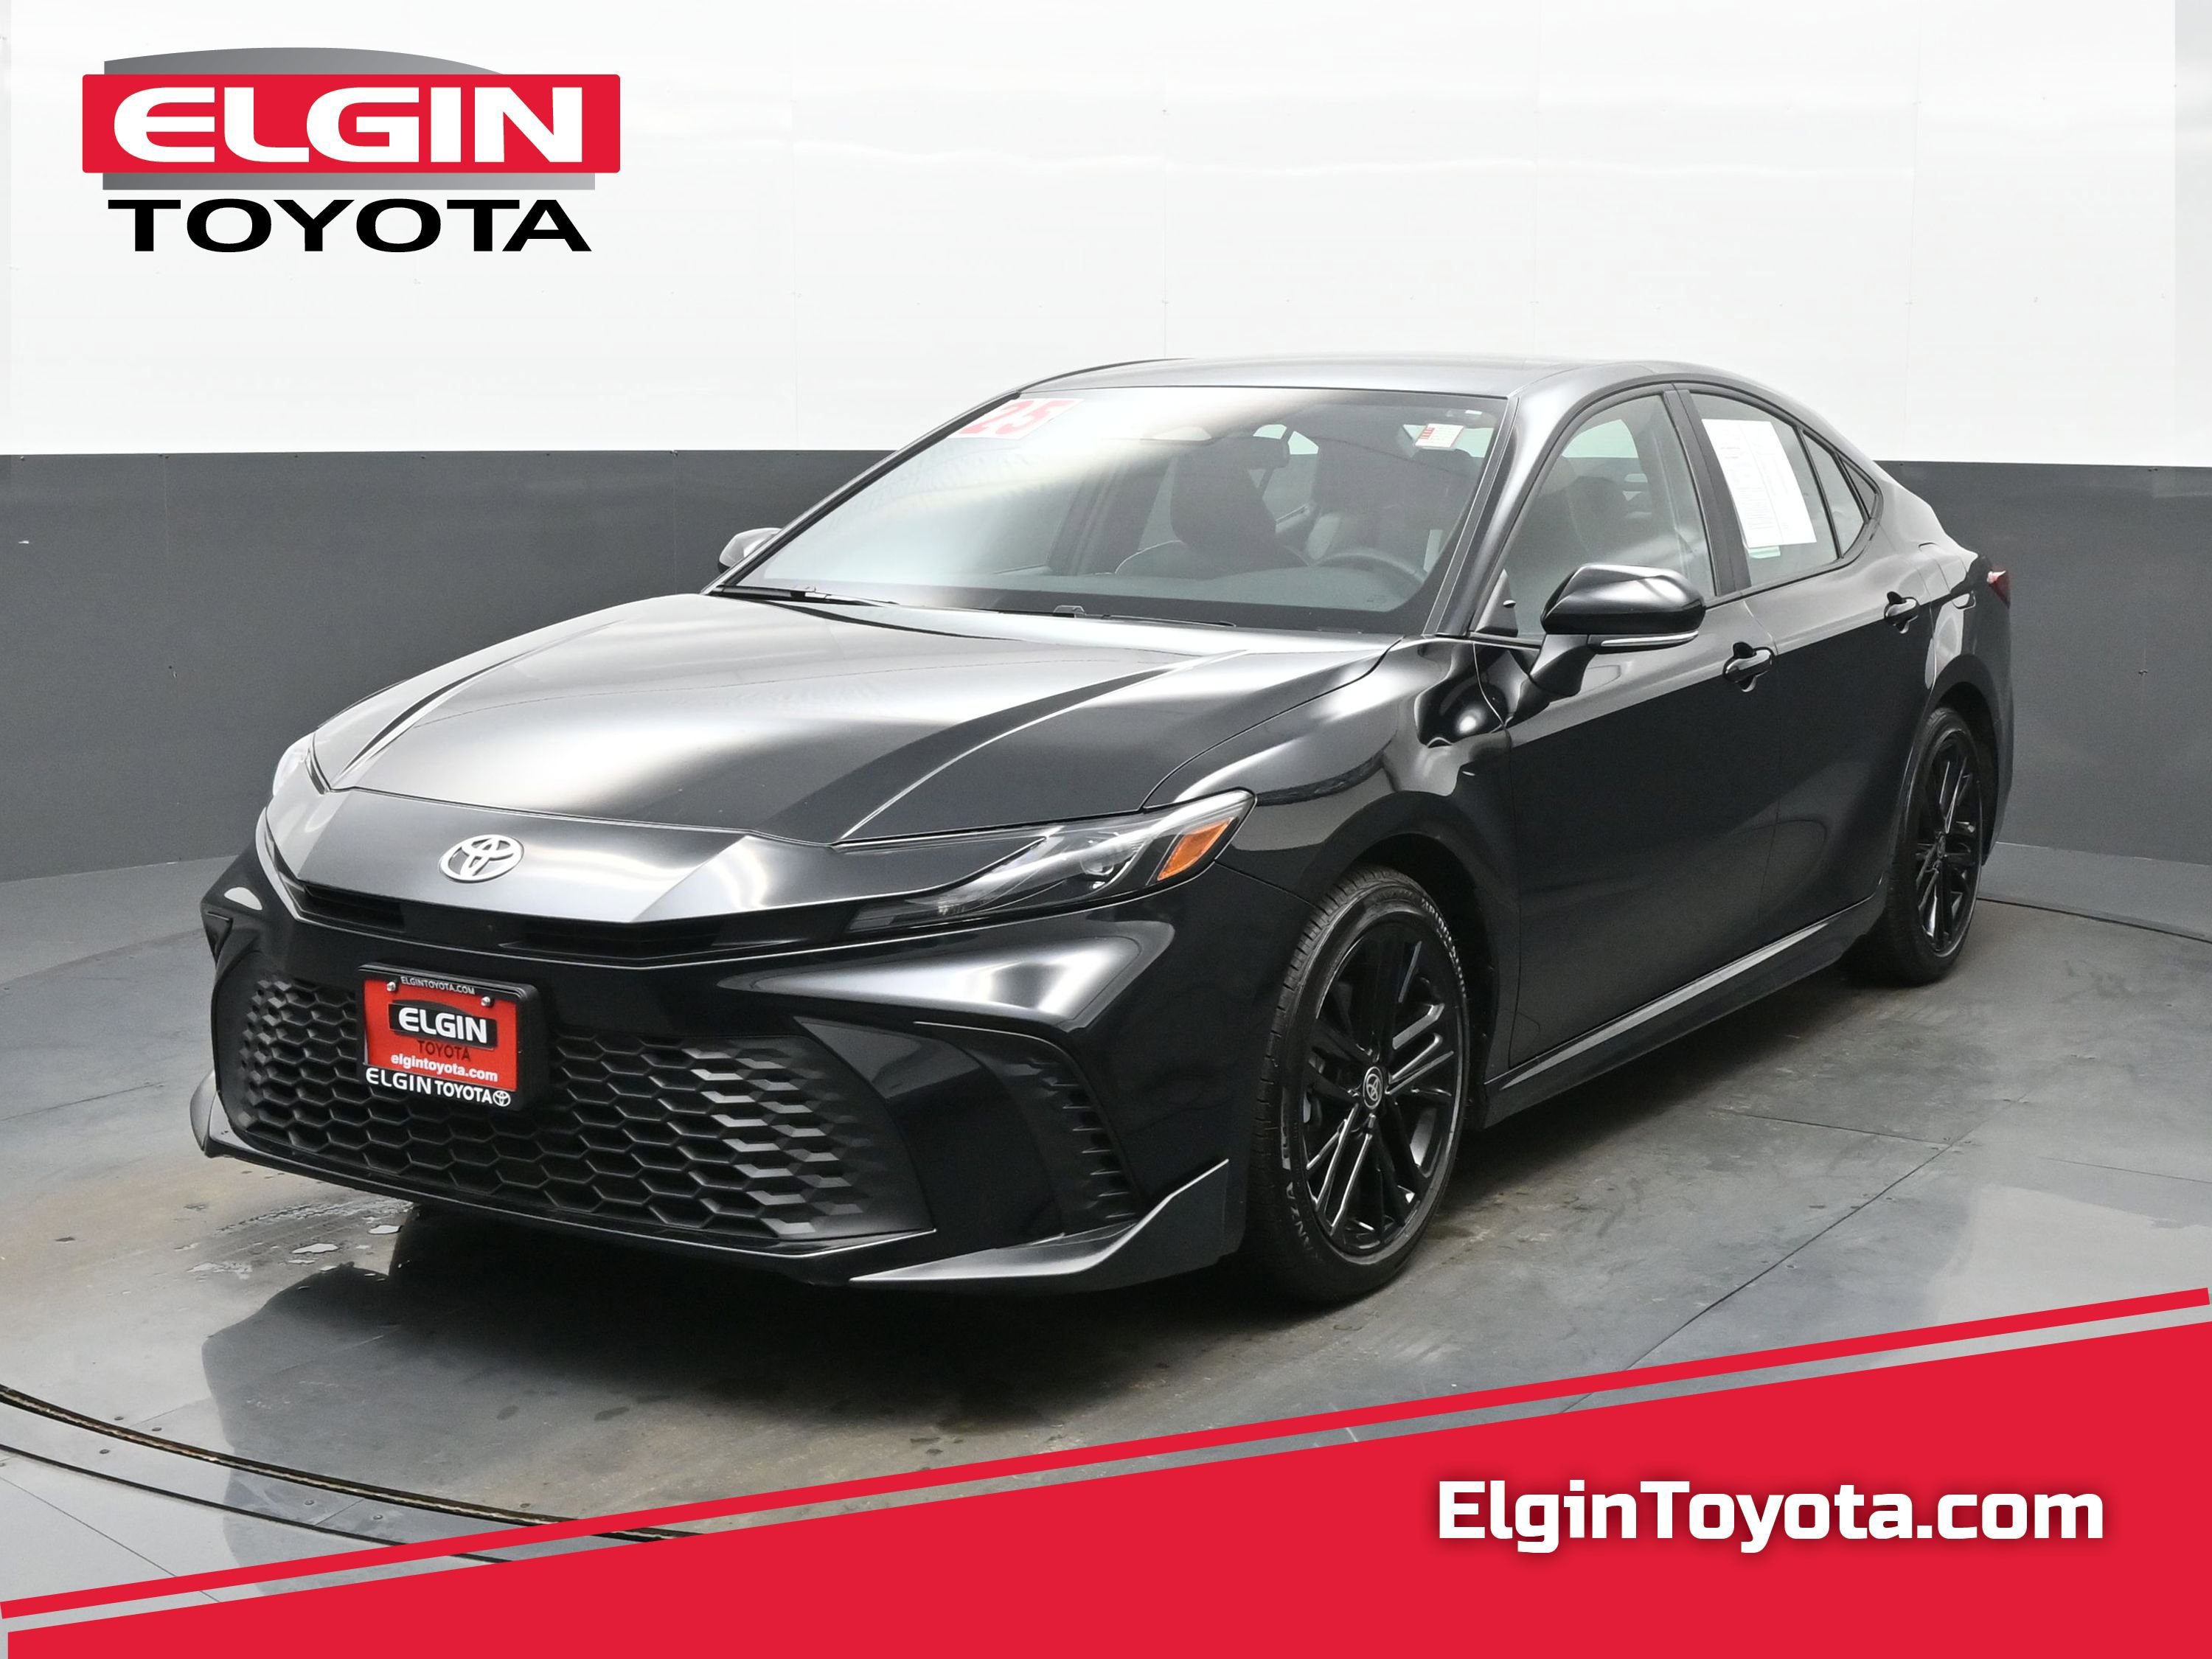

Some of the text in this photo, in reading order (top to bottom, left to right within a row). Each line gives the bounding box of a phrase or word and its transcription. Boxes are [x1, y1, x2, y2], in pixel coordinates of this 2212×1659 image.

[400, 977, 475, 995] ELGINTOYOTA.COM
[398, 1007, 487, 1043] ELGIN
[417, 1040, 470, 1061] TOYOTA
[391, 1053, 498, 1082] elgintoyota.com
[366, 1068, 493, 1104] ELGIN TOYOTA
